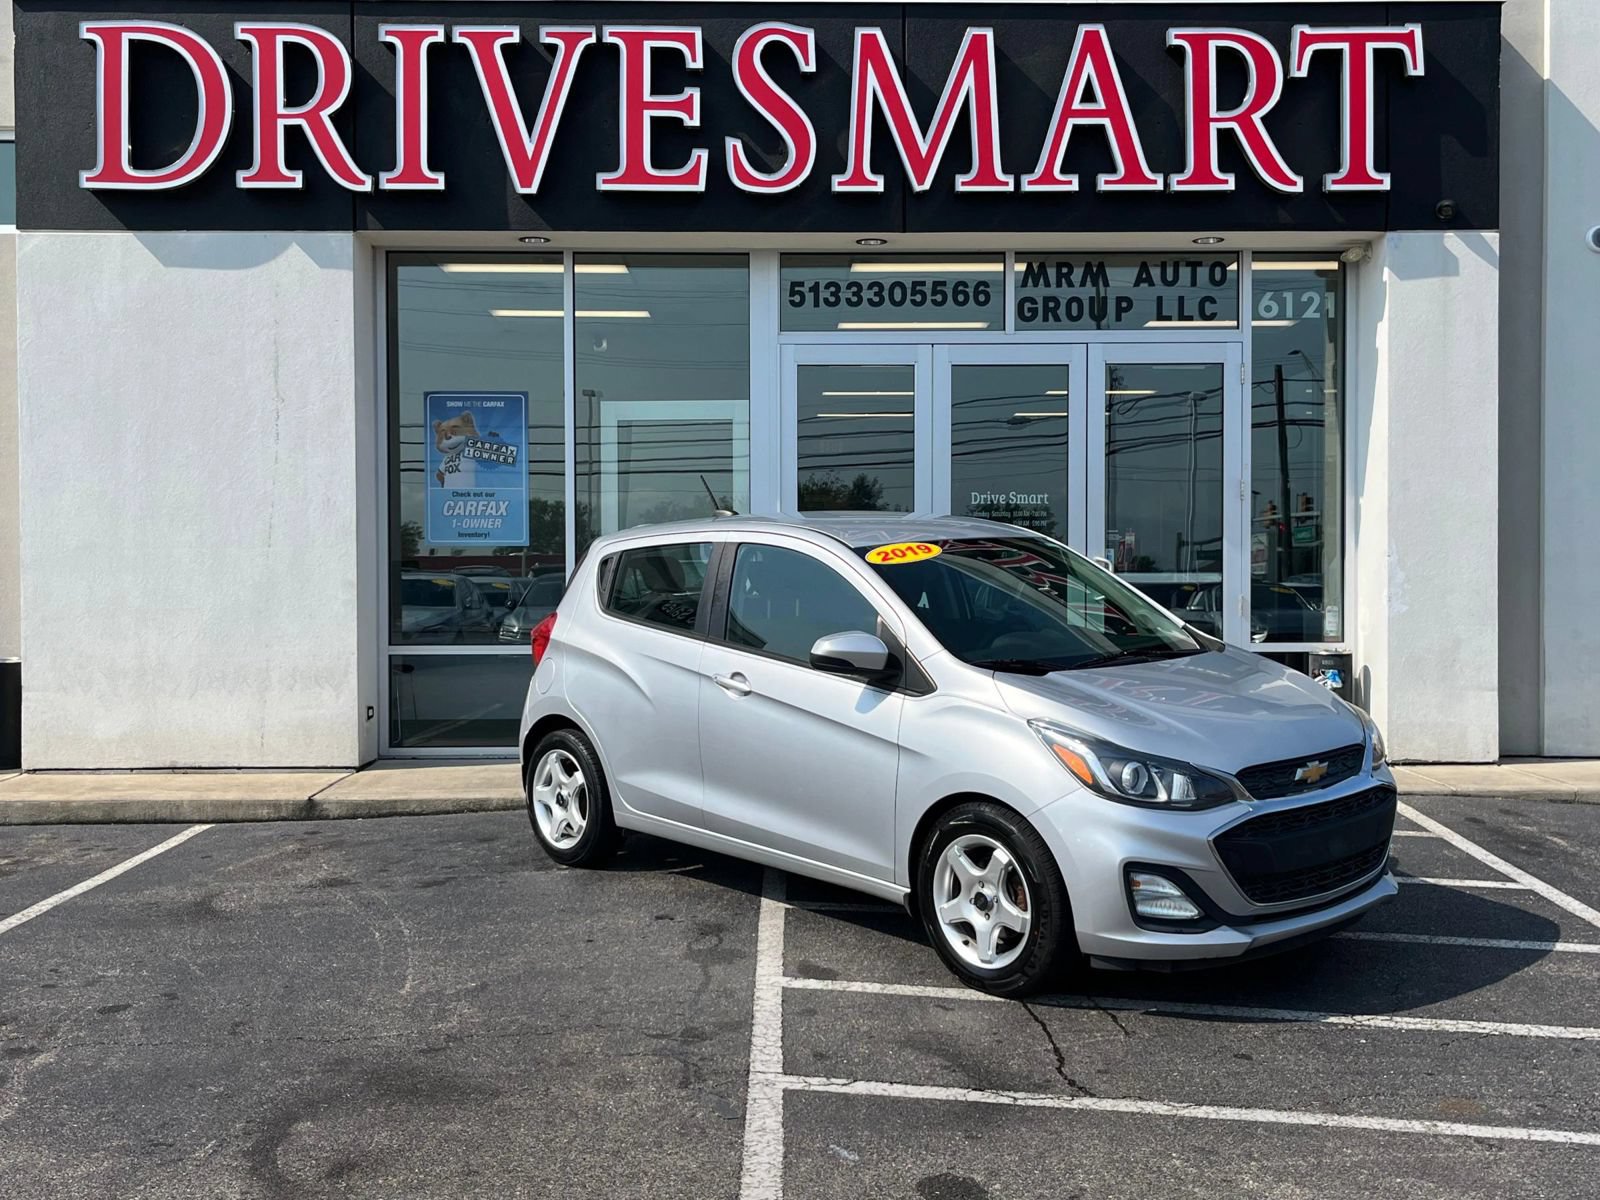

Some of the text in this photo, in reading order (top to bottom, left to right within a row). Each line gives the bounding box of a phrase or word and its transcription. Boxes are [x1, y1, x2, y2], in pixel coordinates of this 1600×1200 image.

[78, 20, 1425, 195] DRIVESMART
[1021, 260, 1228, 288] MRM AUTO
[788, 280, 992, 308] 5133305566
[1017, 295, 1219, 323] GROUP LLC
[1257, 291, 1336, 319] 6121
[446, 400, 463, 408] SHOW
[482, 400, 505, 408] CARFAX
[467, 439, 518, 456] CARFAX
[444, 463, 462, 474] FOX
[971, 491, 1049, 505] Drive Smart
[443, 500, 510, 517] CARFAX
[876, 544, 934, 562] 2019
